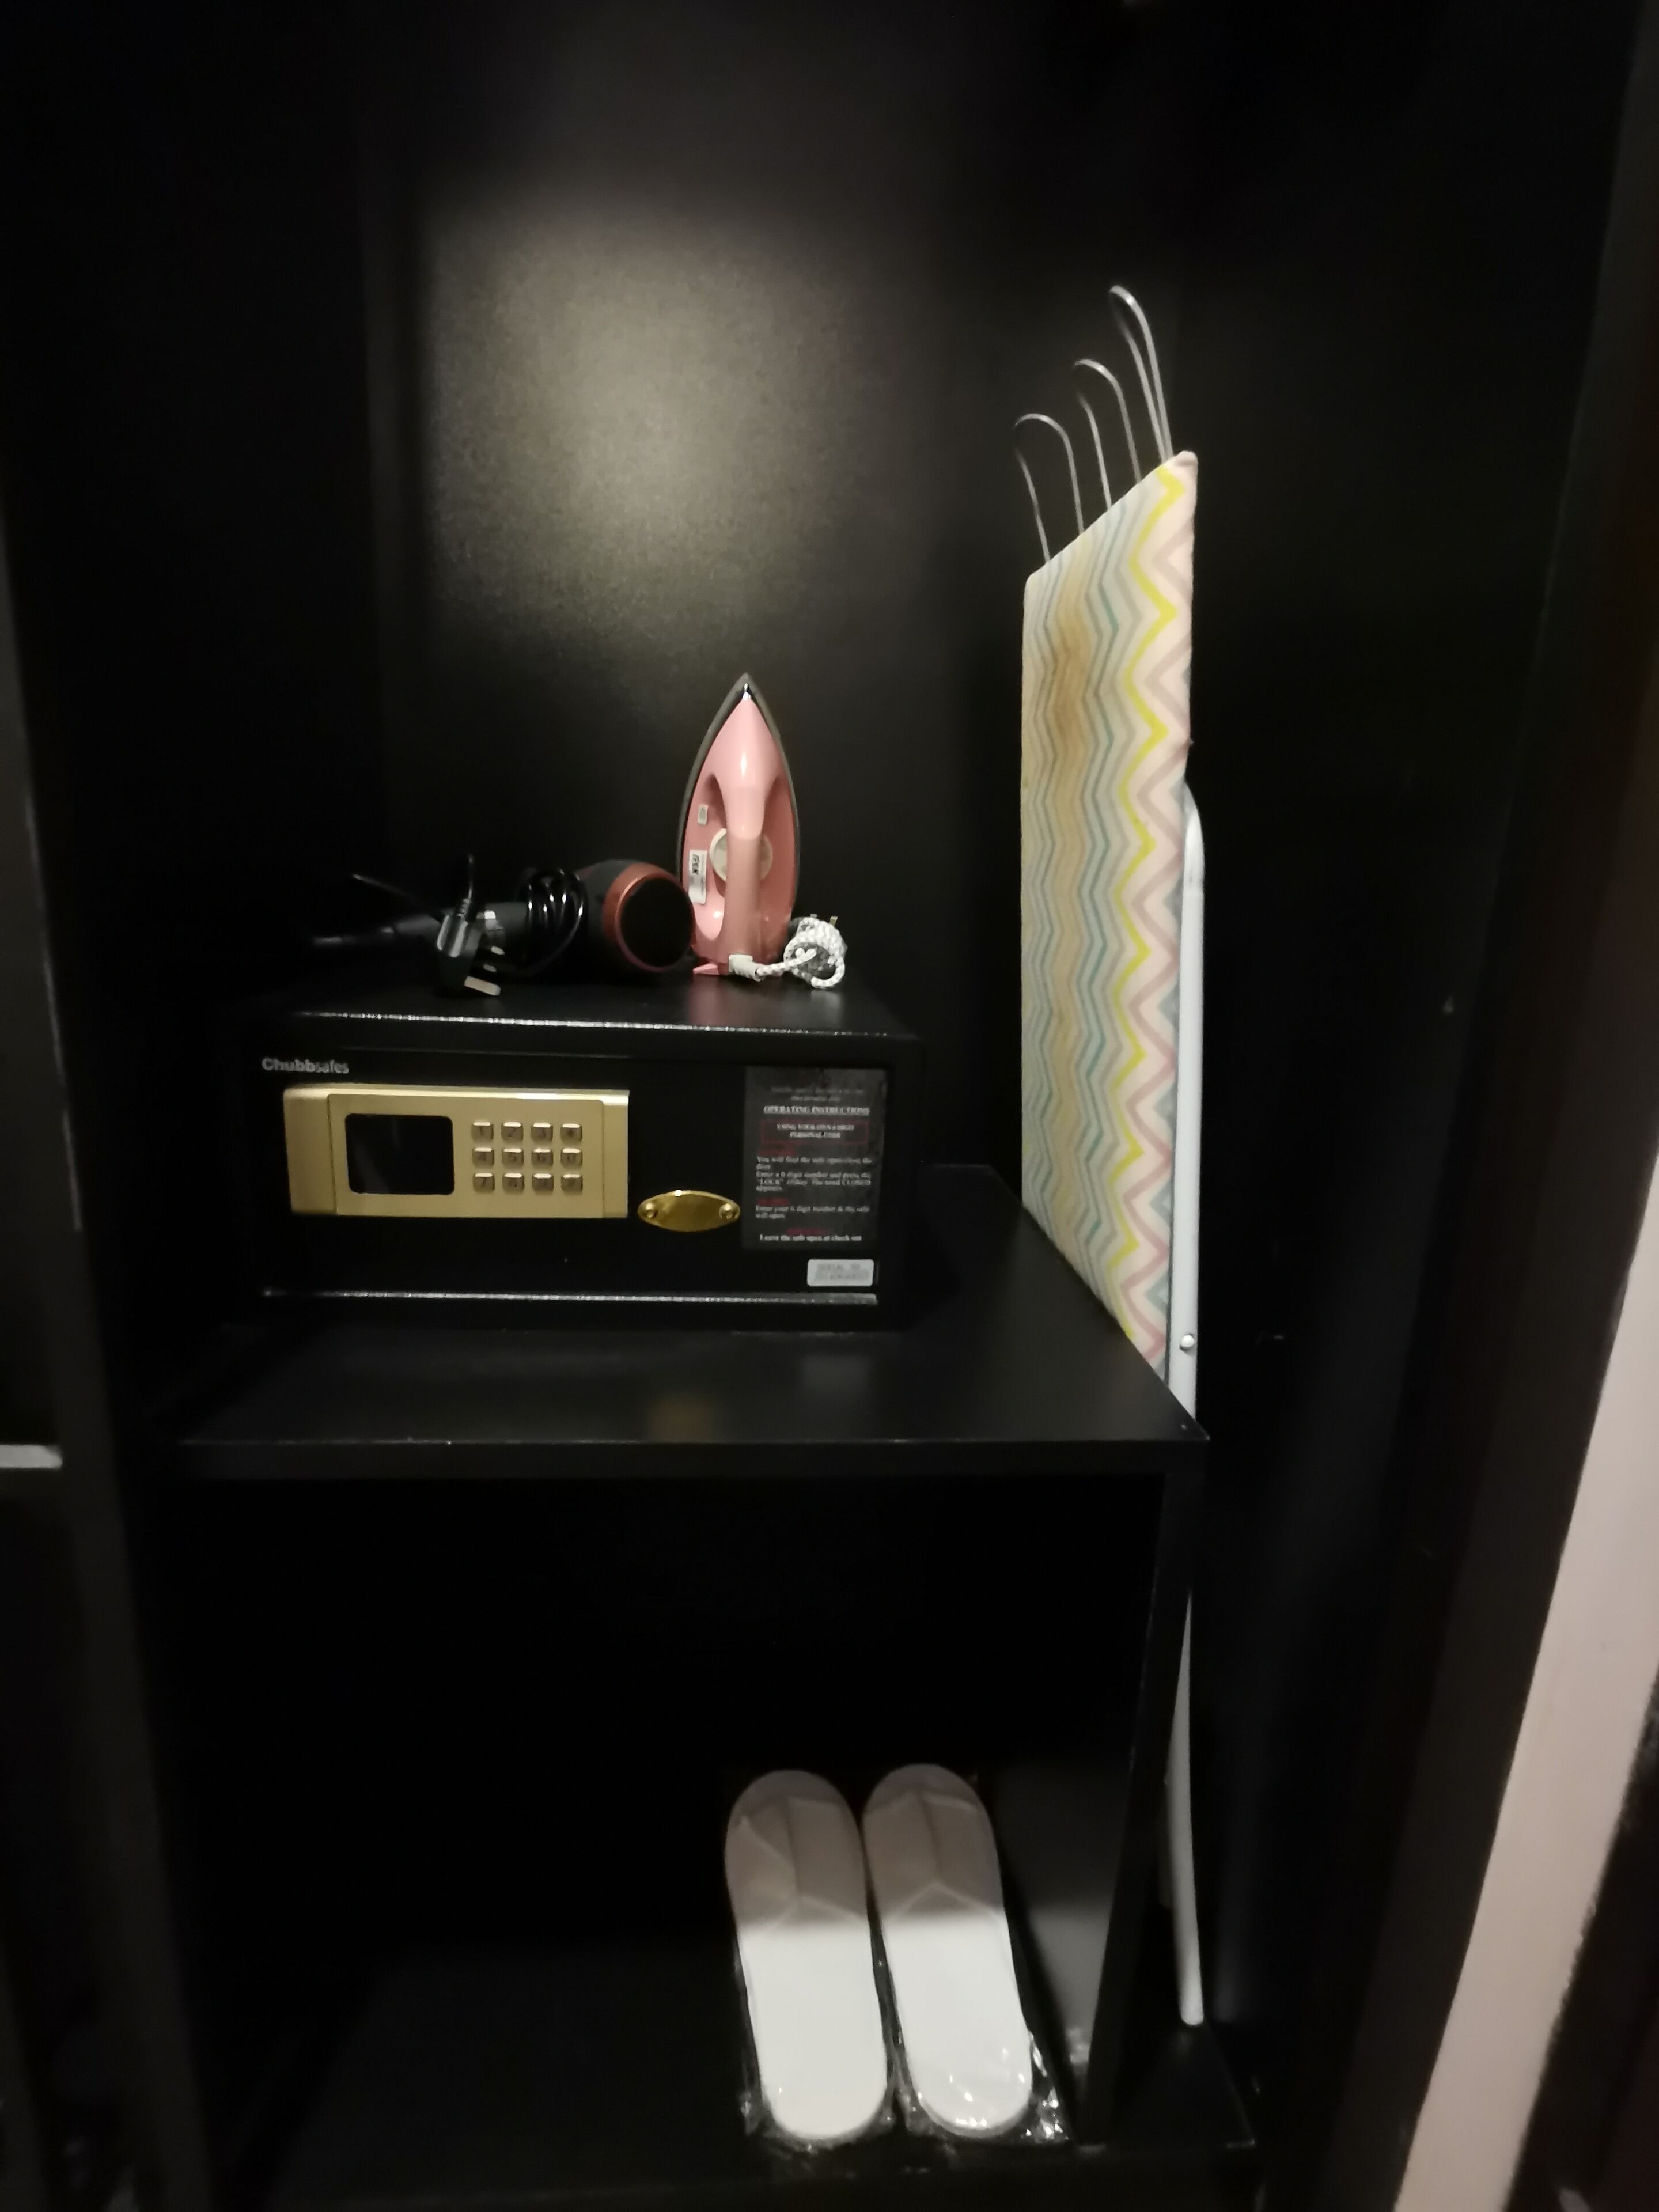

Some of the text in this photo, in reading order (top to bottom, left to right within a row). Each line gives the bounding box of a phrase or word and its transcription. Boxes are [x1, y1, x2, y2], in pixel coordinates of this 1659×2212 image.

[262, 1058, 350, 1074] Chubbsafes
[763, 1105, 870, 1116] OPERATING INSTRUCTIONS
